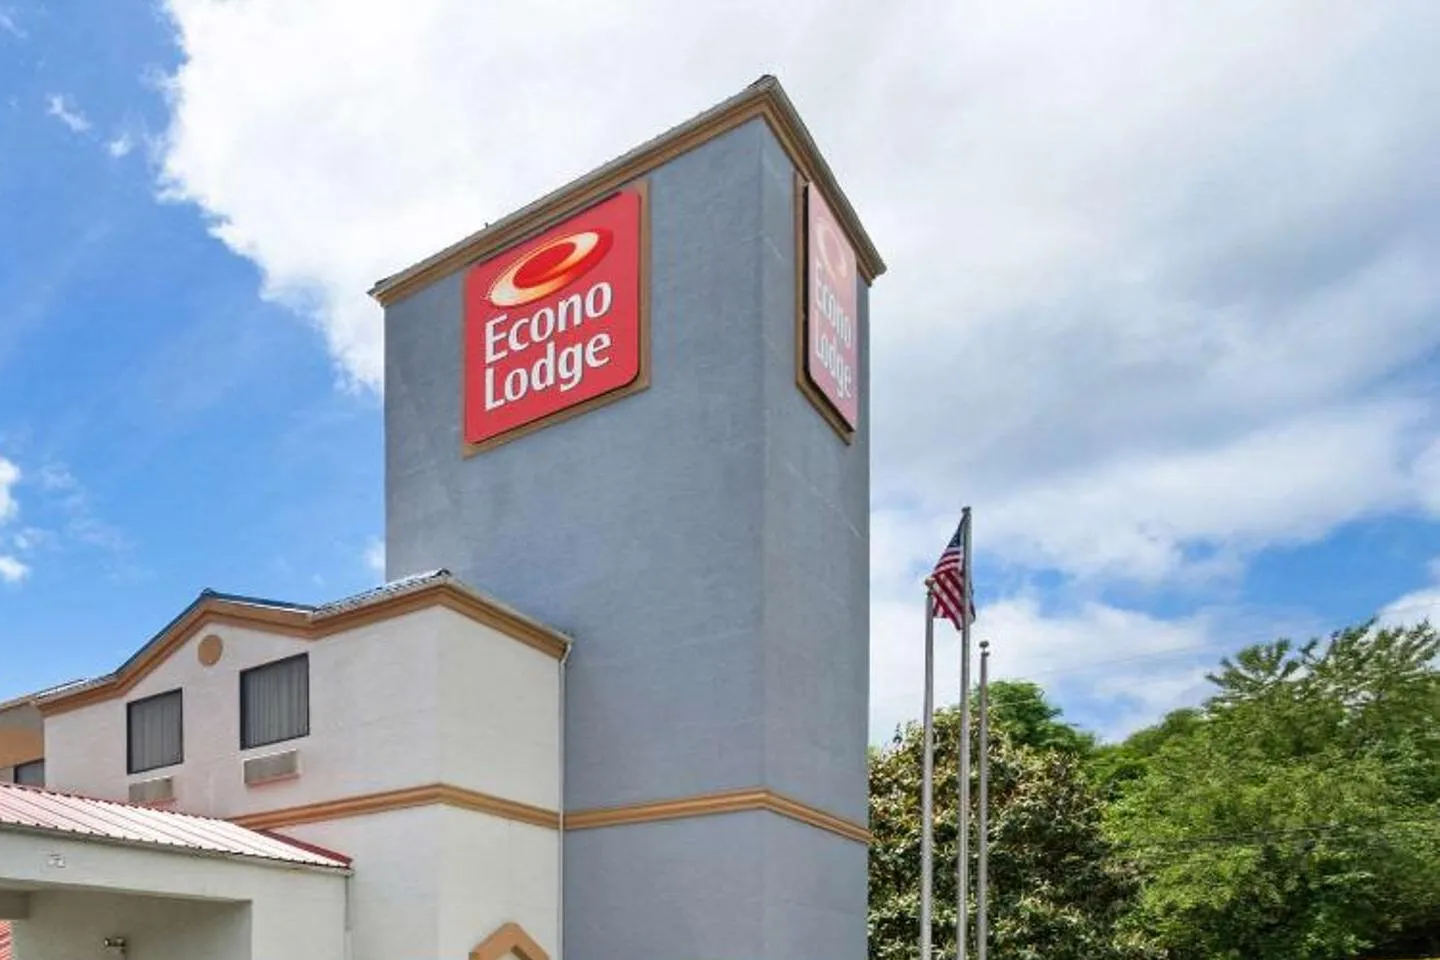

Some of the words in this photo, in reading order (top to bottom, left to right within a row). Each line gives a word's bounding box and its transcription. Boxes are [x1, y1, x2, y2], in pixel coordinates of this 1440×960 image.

[484, 281, 611, 364] Econo
[815, 258, 851, 348] Econo
[484, 332, 611, 411] Lodge
[815, 309, 851, 398] Lodge
